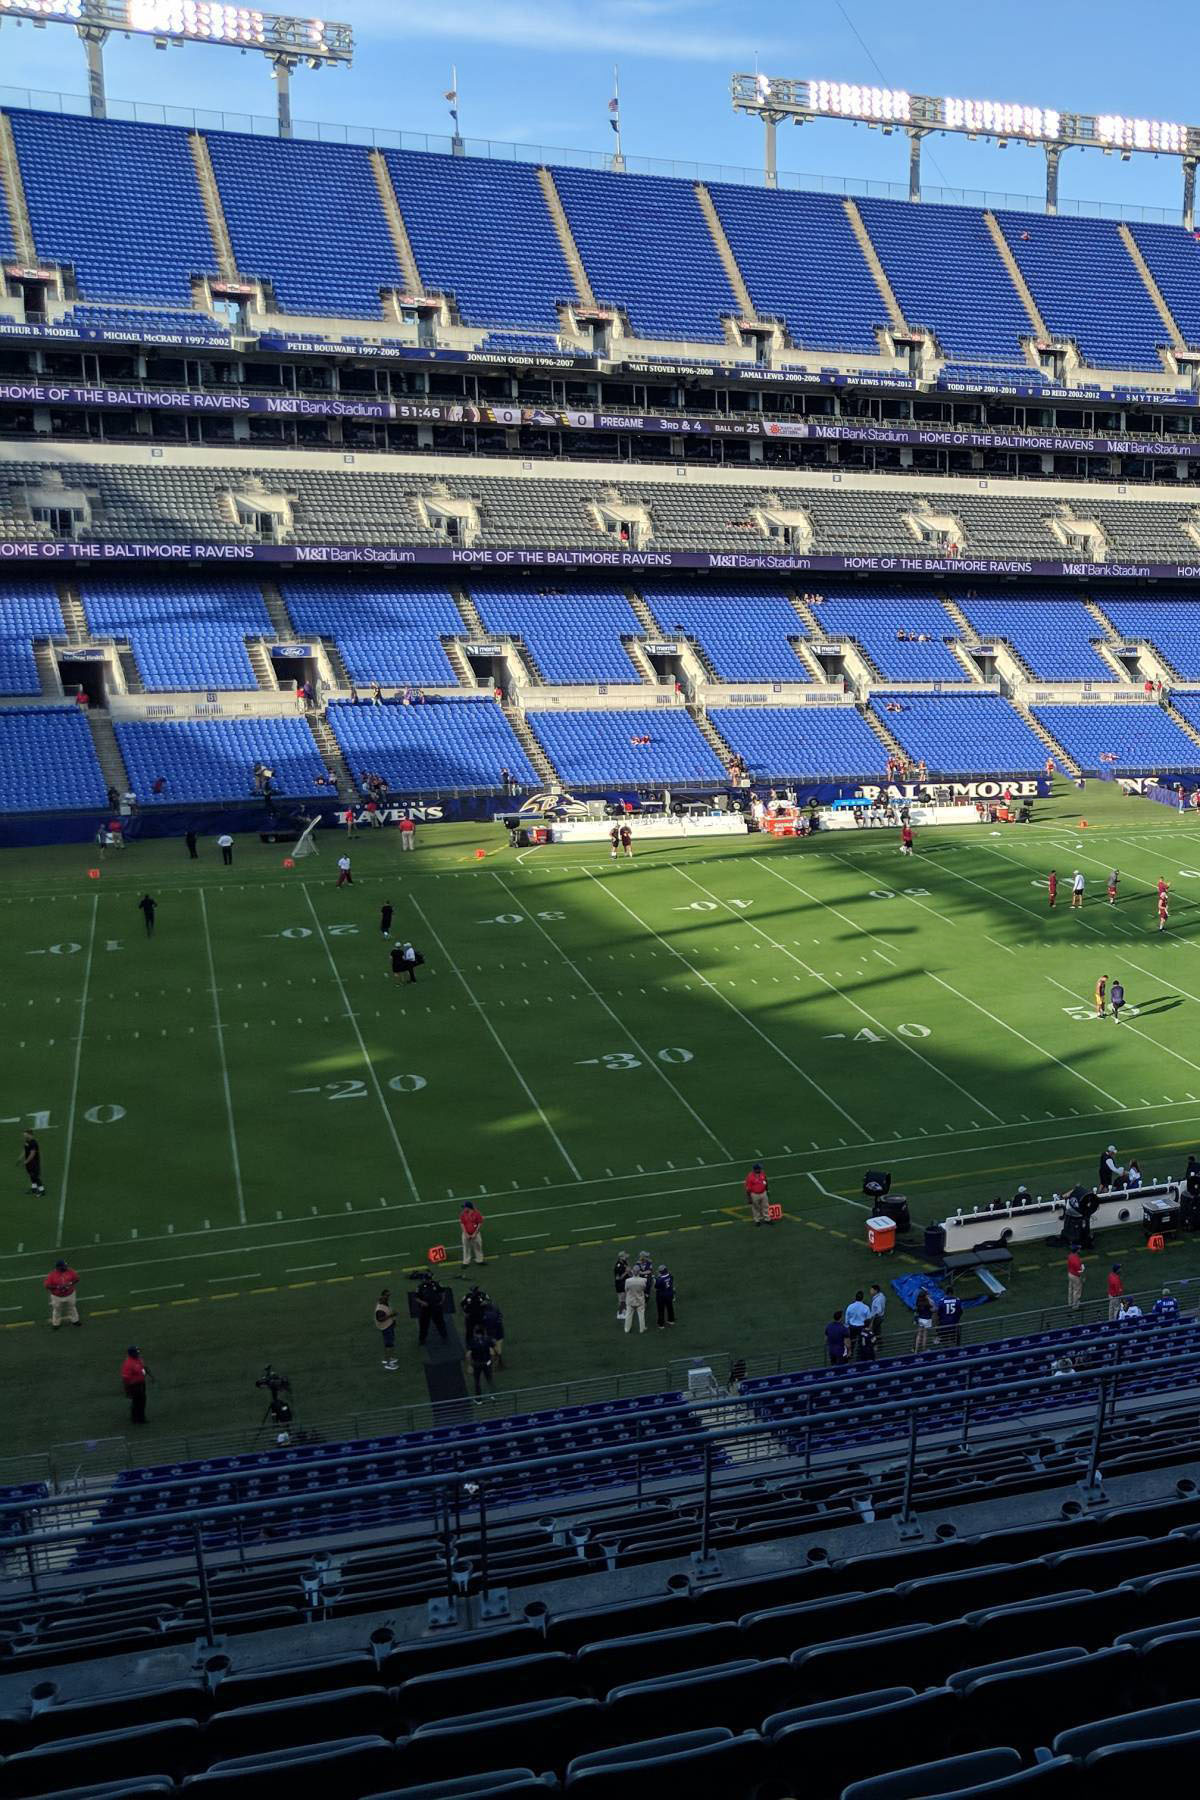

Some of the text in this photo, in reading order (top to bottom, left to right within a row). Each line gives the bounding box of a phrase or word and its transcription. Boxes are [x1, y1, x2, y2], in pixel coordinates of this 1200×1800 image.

[0, 326, 80, 338] RTHUR B. MODELL
[104, 331, 230, 346] MICHAEL McCRARY 1997-2002
[288, 343, 400, 356] PETER BOULWARE 1997-2005
[467, 353, 574, 367] JONATHAN OGDEN 1996-2007
[629, 364, 648, 372] MATT
[650, 365, 675, 374] STOVER
[740, 371, 762, 379] JAMAL
[764, 372, 784, 380] LEWIS
[861, 378, 879, 386] LEWIS
[0, 387, 250, 409] HOME OF THE BALTIMORE RAVENS
[1068, 390, 1100, 398] 2002-2012
[1126, 394, 1159, 402] SMYTH
[267, 398, 382, 416] M&T Bank Stadium
[401, 406, 441, 418] 51:46
[504, 411, 512, 422] 0
[578, 415, 586, 426] 0
[601, 417, 644, 428] PREGAME
[660, 420, 702, 430] 3RD & 4
[746, 424, 760, 434] 25
[816, 426, 842, 438] M&T
[842, 427, 868, 439] Bank
[868, 429, 909, 442] Stadium
[920, 433, 1094, 450] HOME OF THE BALTIMORE RAVENS
[1107, 442, 1190, 455] M&T Bank Stadium
[0, 544, 254, 558] OME OF THE BALTIMORE RAVENS
[296, 547, 416, 562] M&T Bank Stadium
[452, 551, 672, 565] HOME OF THE BALTIMORE RAVENS
[709, 554, 810, 569] M&T Bank Stadium
[844, 558, 1032, 572] HOME OF THE BALTIMORE RAVENS
[1063, 564, 1150, 577] M&T Bank Stadium
[769, 1206, 781, 1218] 30
[868, 1230, 875, 1244] G
[1152, 1238, 1164, 1248] 40
[432, 1248, 444, 1260] 20
[946, 1304, 956, 1314] 15
